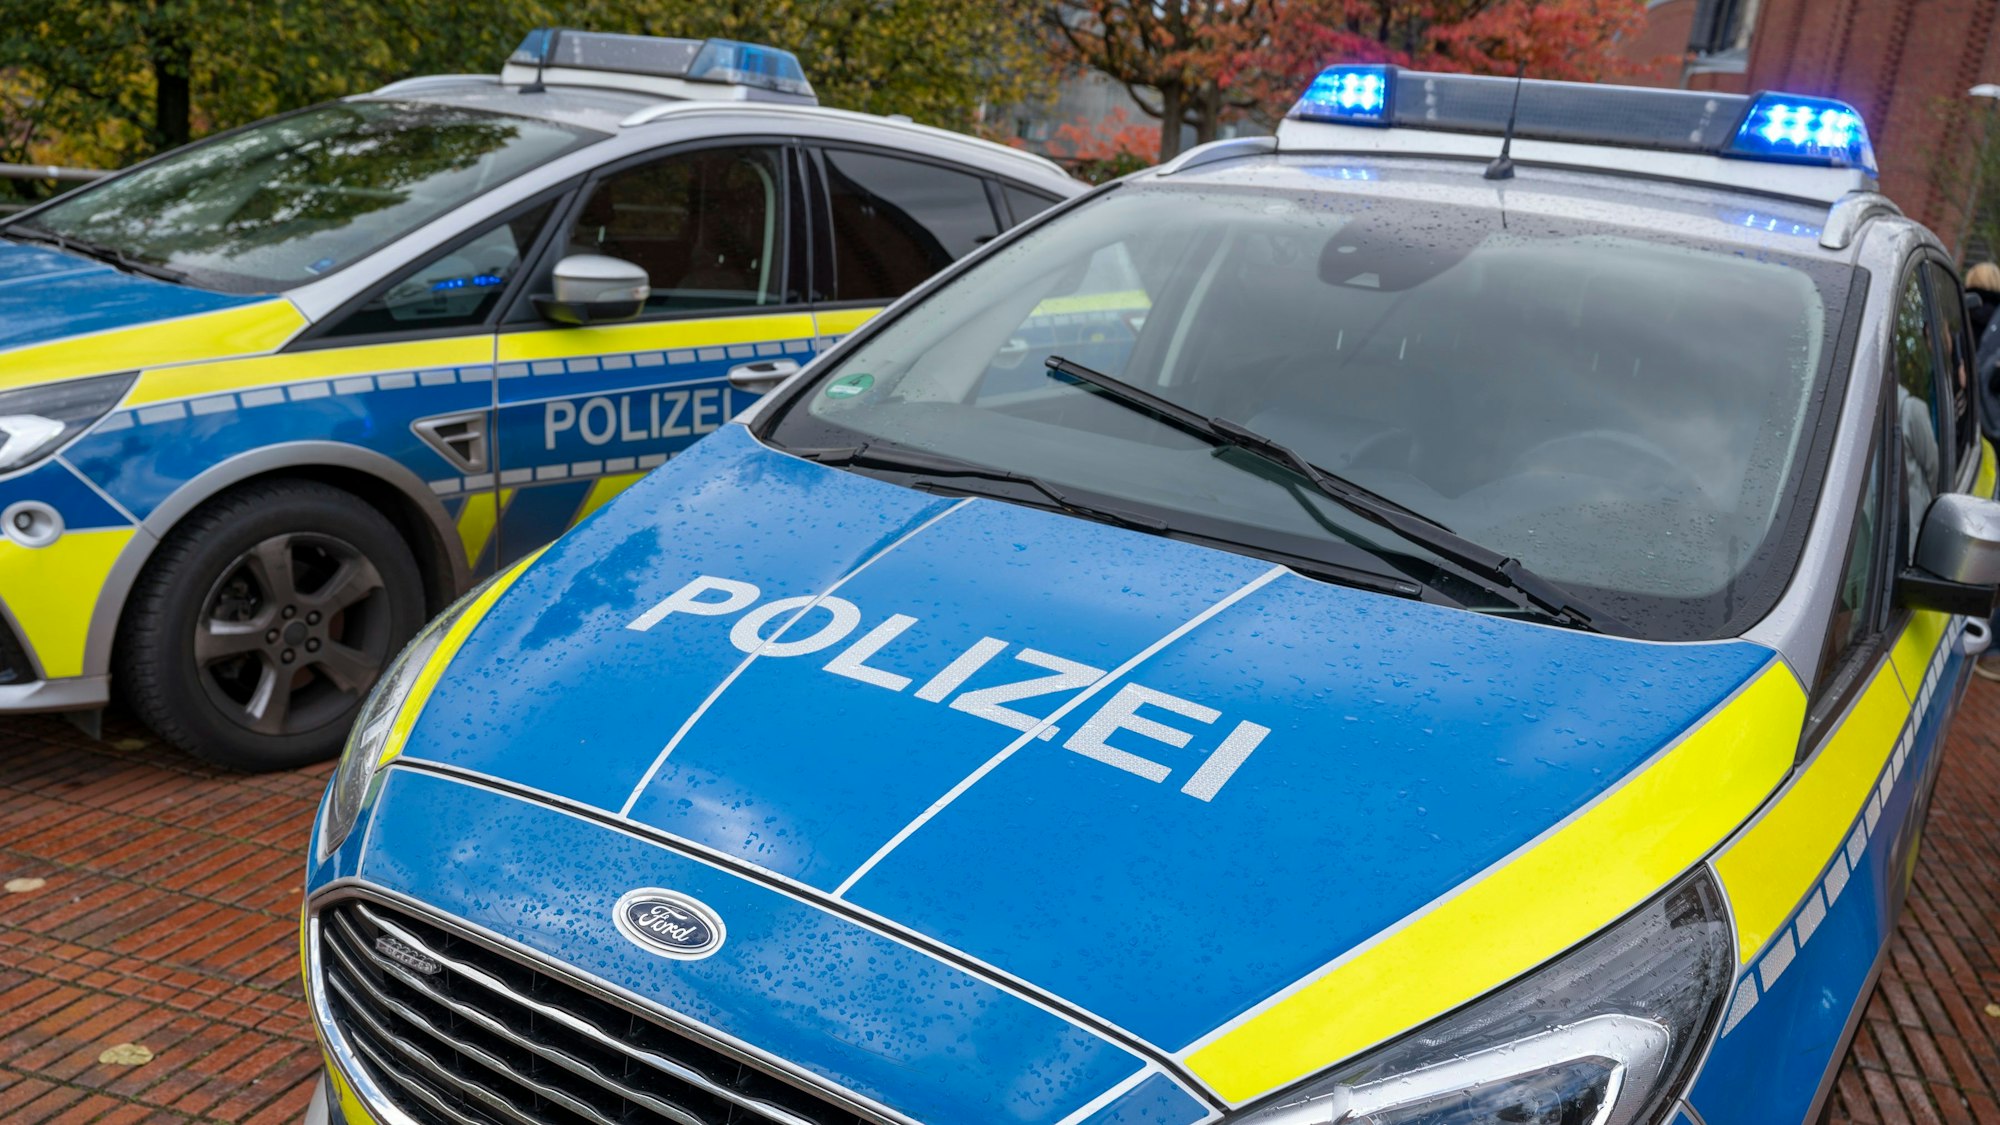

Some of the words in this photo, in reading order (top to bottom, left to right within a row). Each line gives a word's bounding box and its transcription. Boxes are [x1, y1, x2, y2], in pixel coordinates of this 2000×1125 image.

[544, 387, 731, 450] POLIZEI
[625, 575, 1271, 802] POLIZEI
[638, 905, 697, 942] Ford
